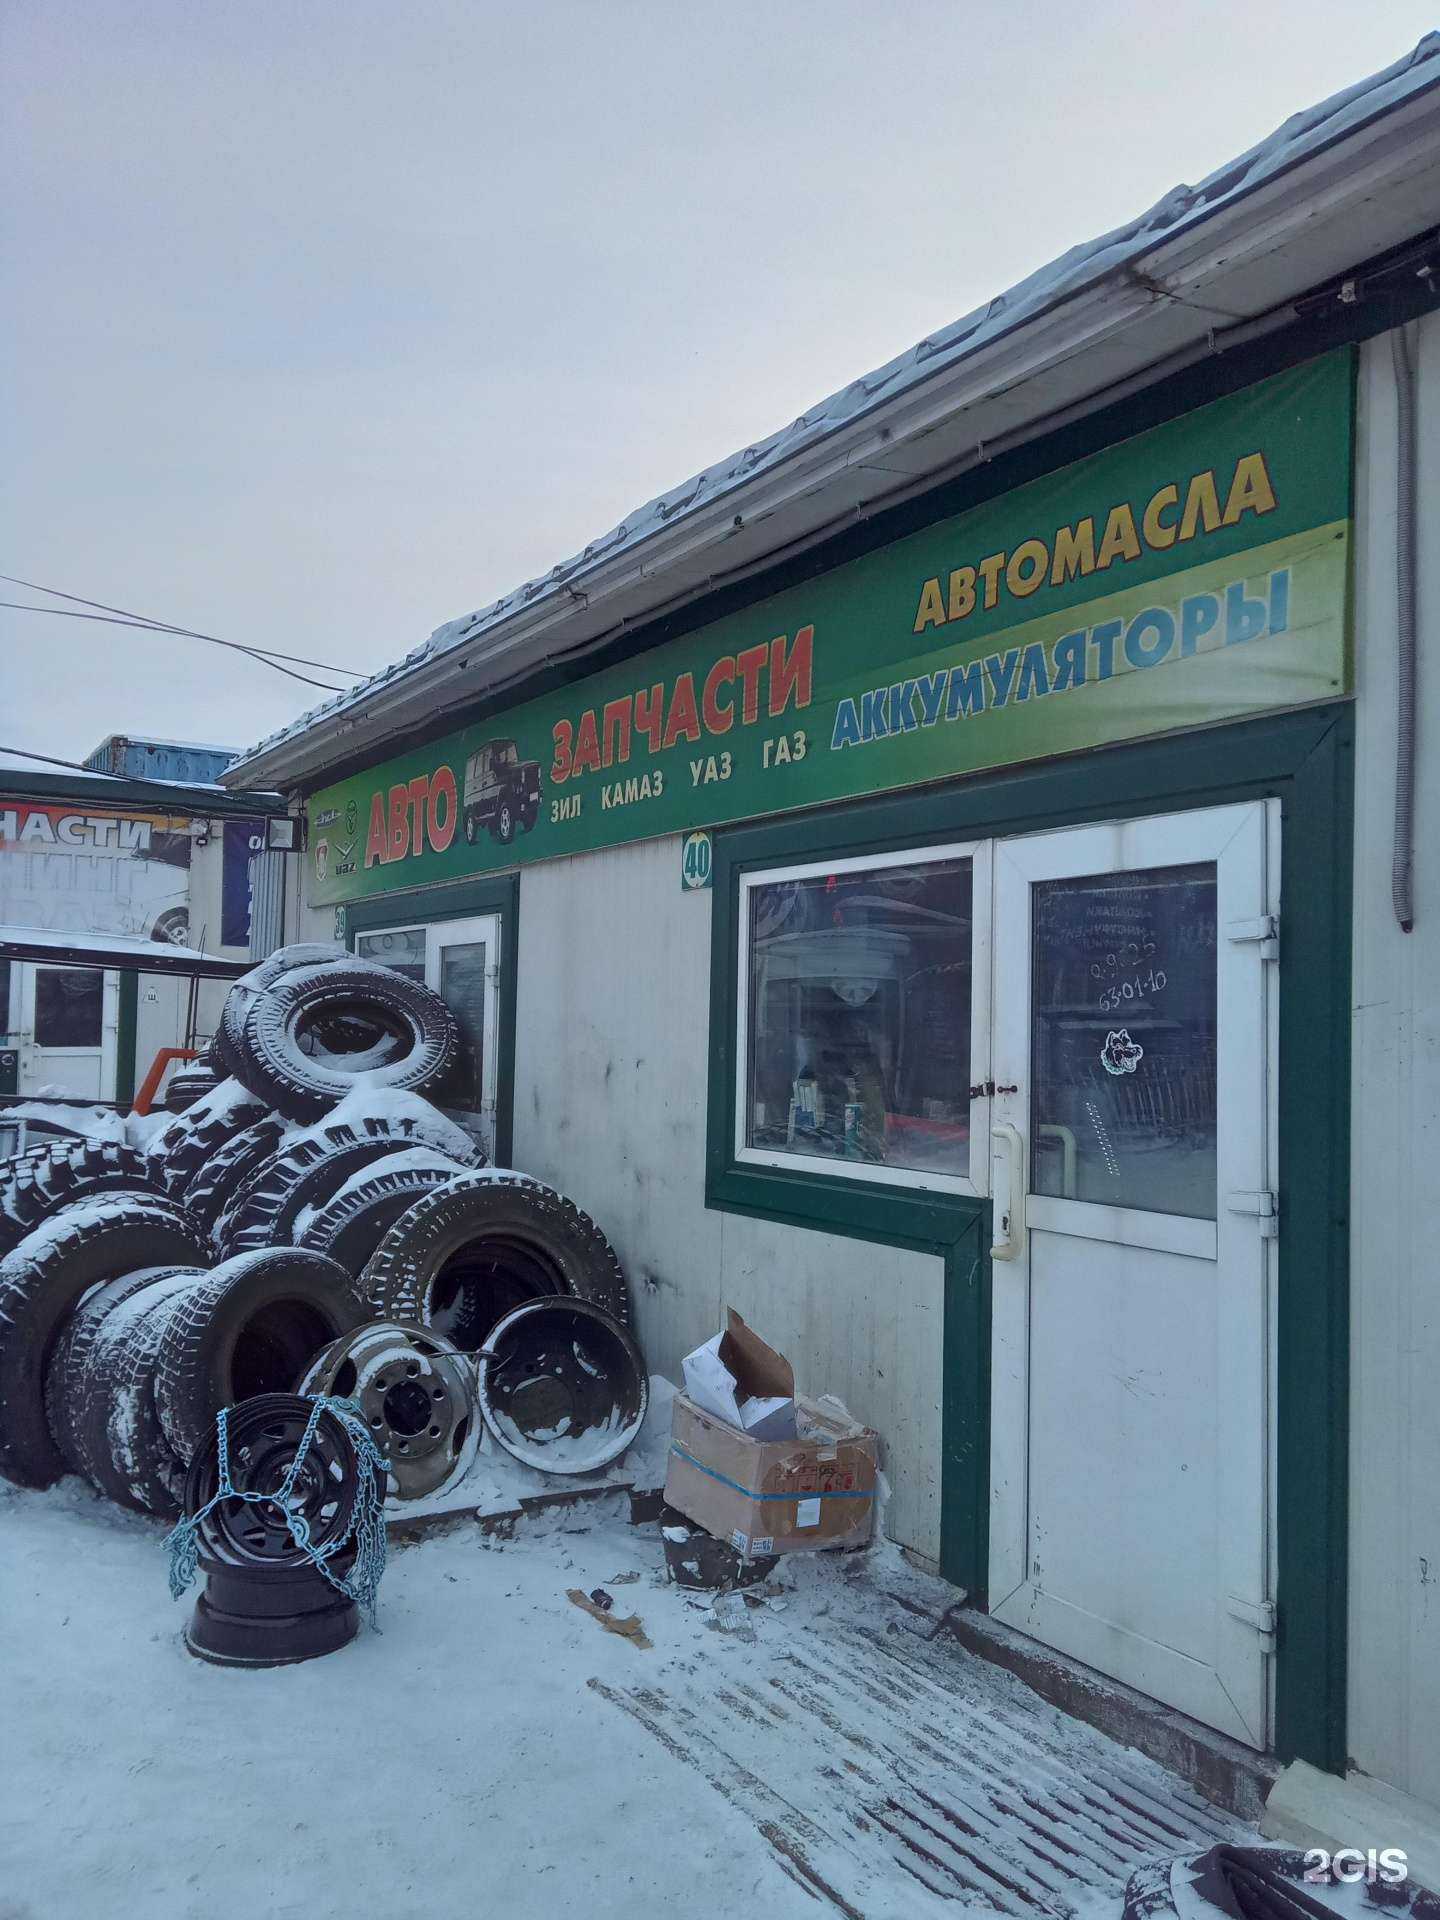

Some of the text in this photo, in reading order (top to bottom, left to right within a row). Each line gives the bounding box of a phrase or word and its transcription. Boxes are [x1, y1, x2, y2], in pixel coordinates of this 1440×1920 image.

[912, 450, 1277, 633] АВТОМАСЛА
[830, 566, 1292, 751] АККУМУЛЯТОРЫ
[364, 624, 815, 870] АВТО ЗАПЧАСТИ
[550, 730, 807, 823] ЗИЛ КАМАЗ УАЗ ГАЗ
[335, 910, 345, 934] 39
[685, 840, 710, 878] 40
